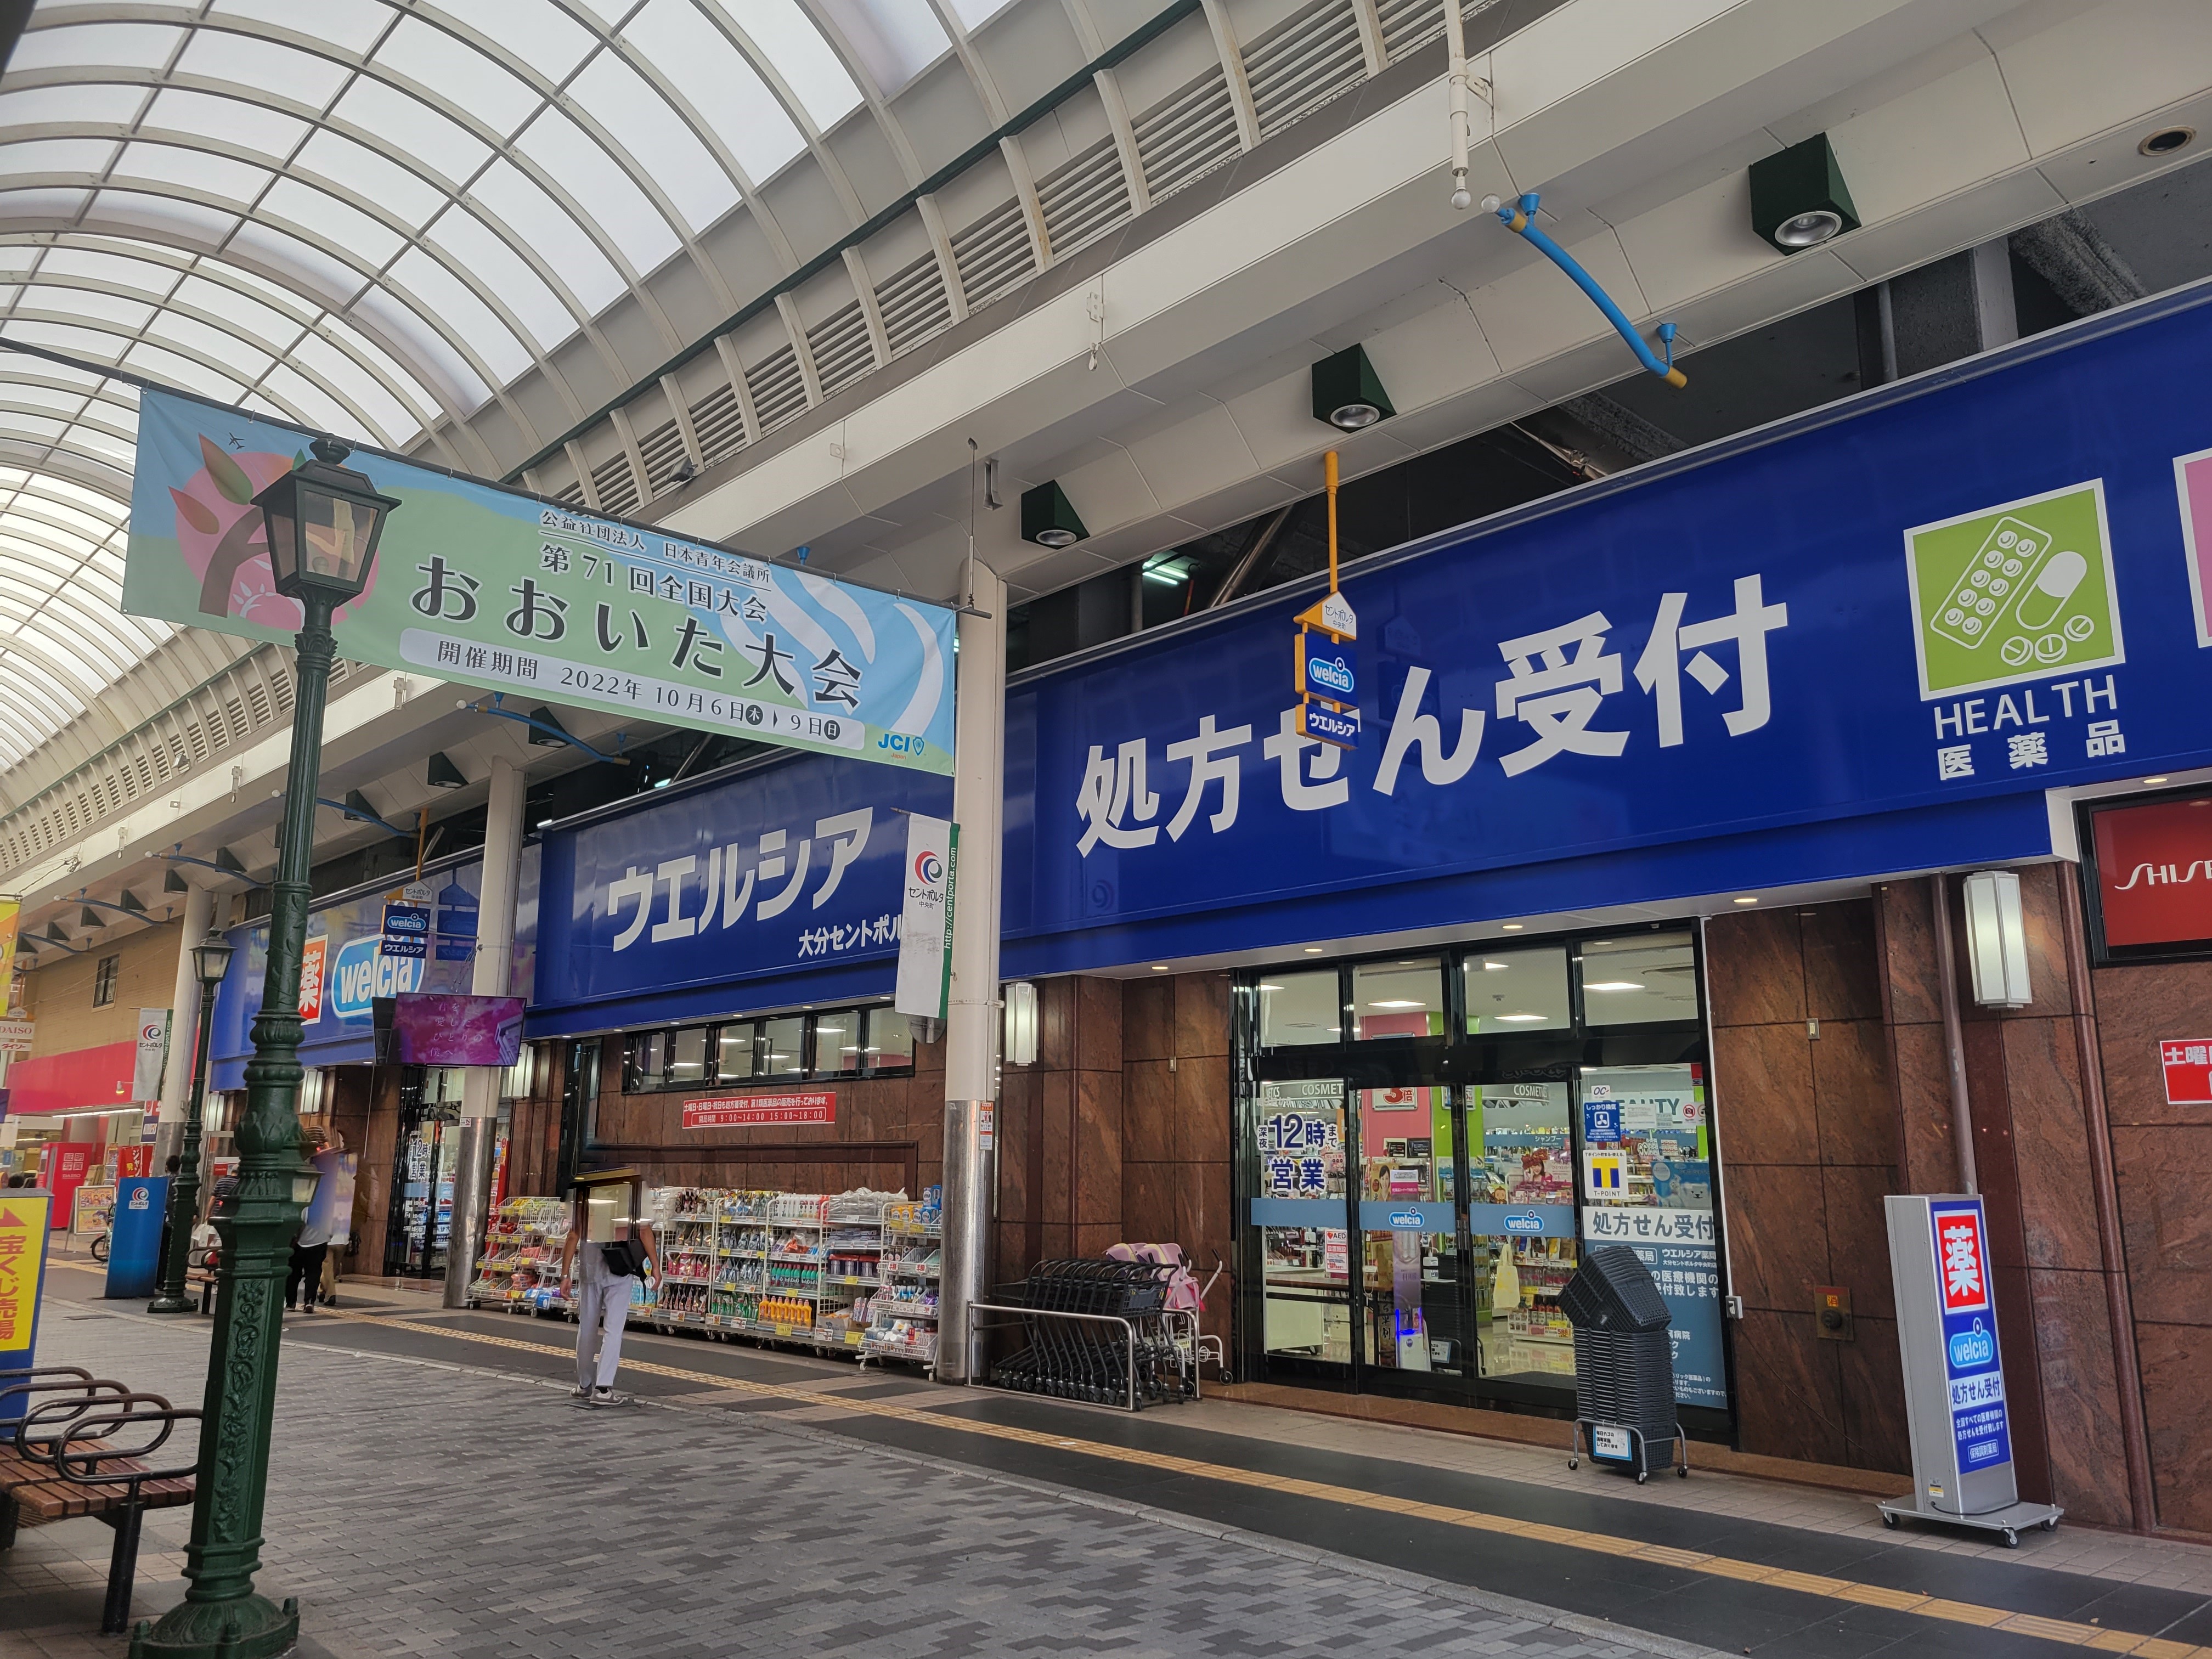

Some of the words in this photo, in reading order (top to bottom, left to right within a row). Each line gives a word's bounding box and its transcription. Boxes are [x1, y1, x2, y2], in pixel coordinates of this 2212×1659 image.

[541, 510, 645, 551] 公益社団法人
[664, 542, 770, 583] 日本青年会議所
[541, 544, 766, 622] 第71回全国大会
[1324, 604, 1353, 624] セントポルタ
[1332, 619, 1346, 631] 中央町
[411, 555, 861, 709] おおいた大会
[437, 640, 539, 680] 開催期間
[560, 667, 643, 701] 2022年
[1312, 664, 1350, 688] welcia
[1076, 573, 1788, 858] 処方せん受付
[1933, 674, 2117, 740] HEALTH
[1309, 713, 1356, 737] ウエルシア
[878, 733, 911, 752] JCI
[1937, 719, 2126, 781] 医薬品
[405, 888, 430, 896] セントポルタ
[607, 806, 873, 952] ウエルシア
[908, 887, 944, 903] セントポルタ
[918, 901, 934, 910] 中央町
[944, 847, 957, 949] http://centporta.com
[390, 918, 421, 929] welcia
[384, 944, 424, 954] ウエルシア
[298, 950, 321, 1012] 薬
[341, 946, 414, 1004] welcia
[2164, 1045, 2212, 1065] 土曜
[1272, 1159, 1325, 1191] 営業
[1392, 1213, 1421, 1226] welcia
[1507, 1218, 1540, 1231] welcia
[1593, 1211, 1715, 1240] 処方せん受付
[1661, 1248, 1717, 1260] ウエルシア薬局
[1943, 1225, 1980, 1296] 薬
[1953, 1337, 1989, 1364] welcia
[1951, 1376, 2001, 1405] 処方せん受付
